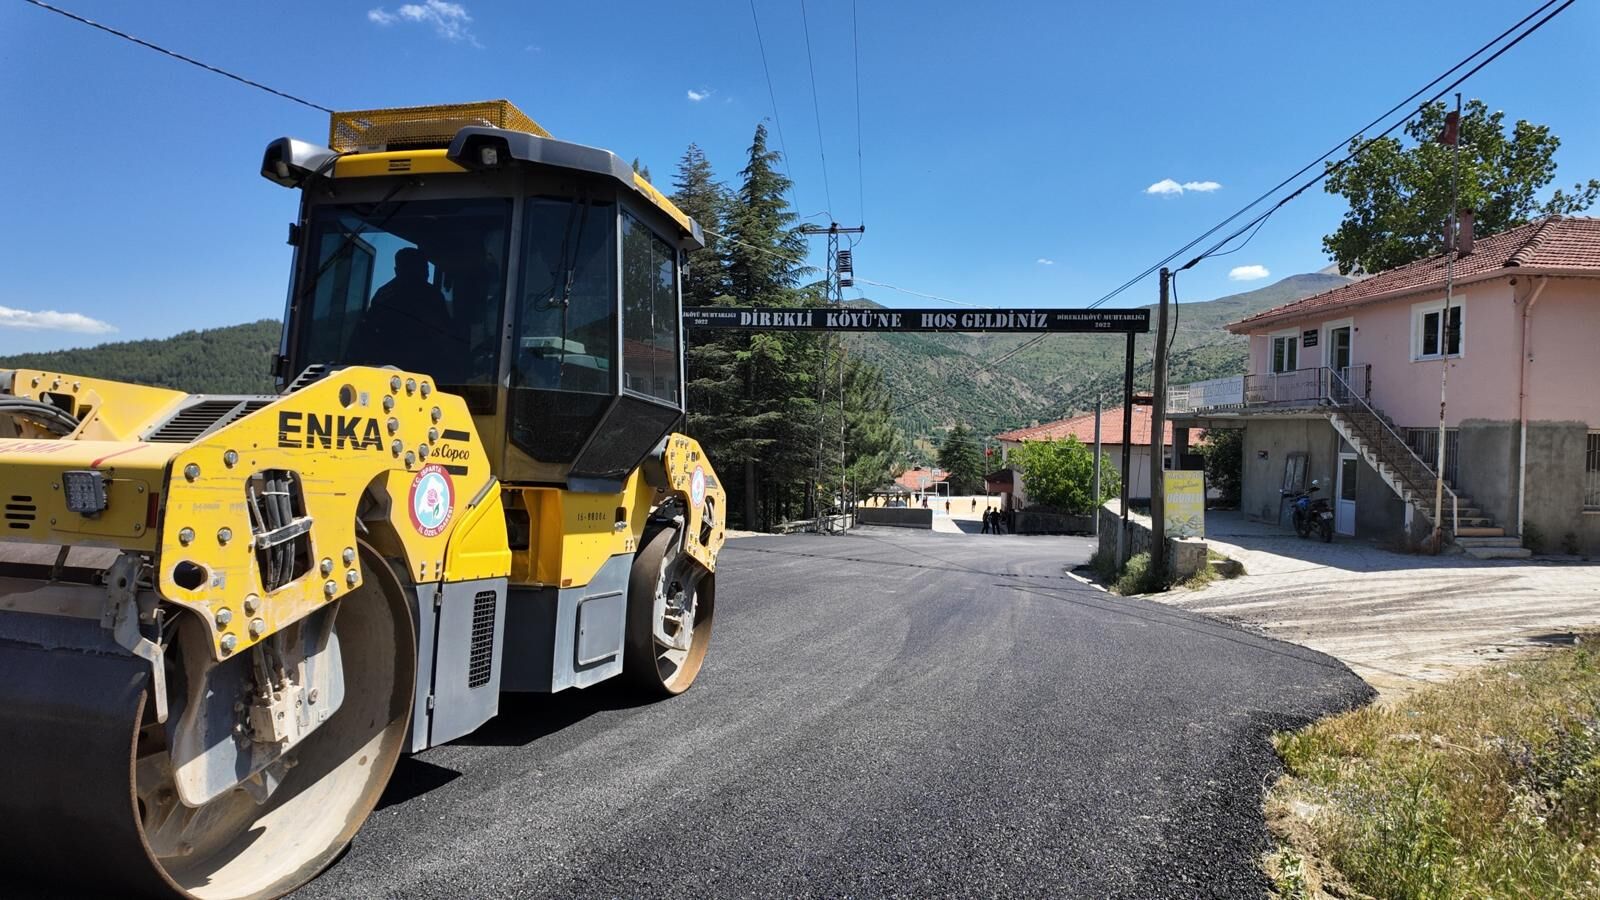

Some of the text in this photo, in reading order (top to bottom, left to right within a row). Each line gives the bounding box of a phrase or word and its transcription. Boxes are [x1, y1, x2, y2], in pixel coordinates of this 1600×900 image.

[740, 309, 813, 327] DİREKLİ
[826, 310, 902, 328] KÖYÜ'NE
[961, 310, 1048, 328] GELDİNİZ
[278, 411, 384, 451] ENKA
[441, 443, 470, 462] Copco
